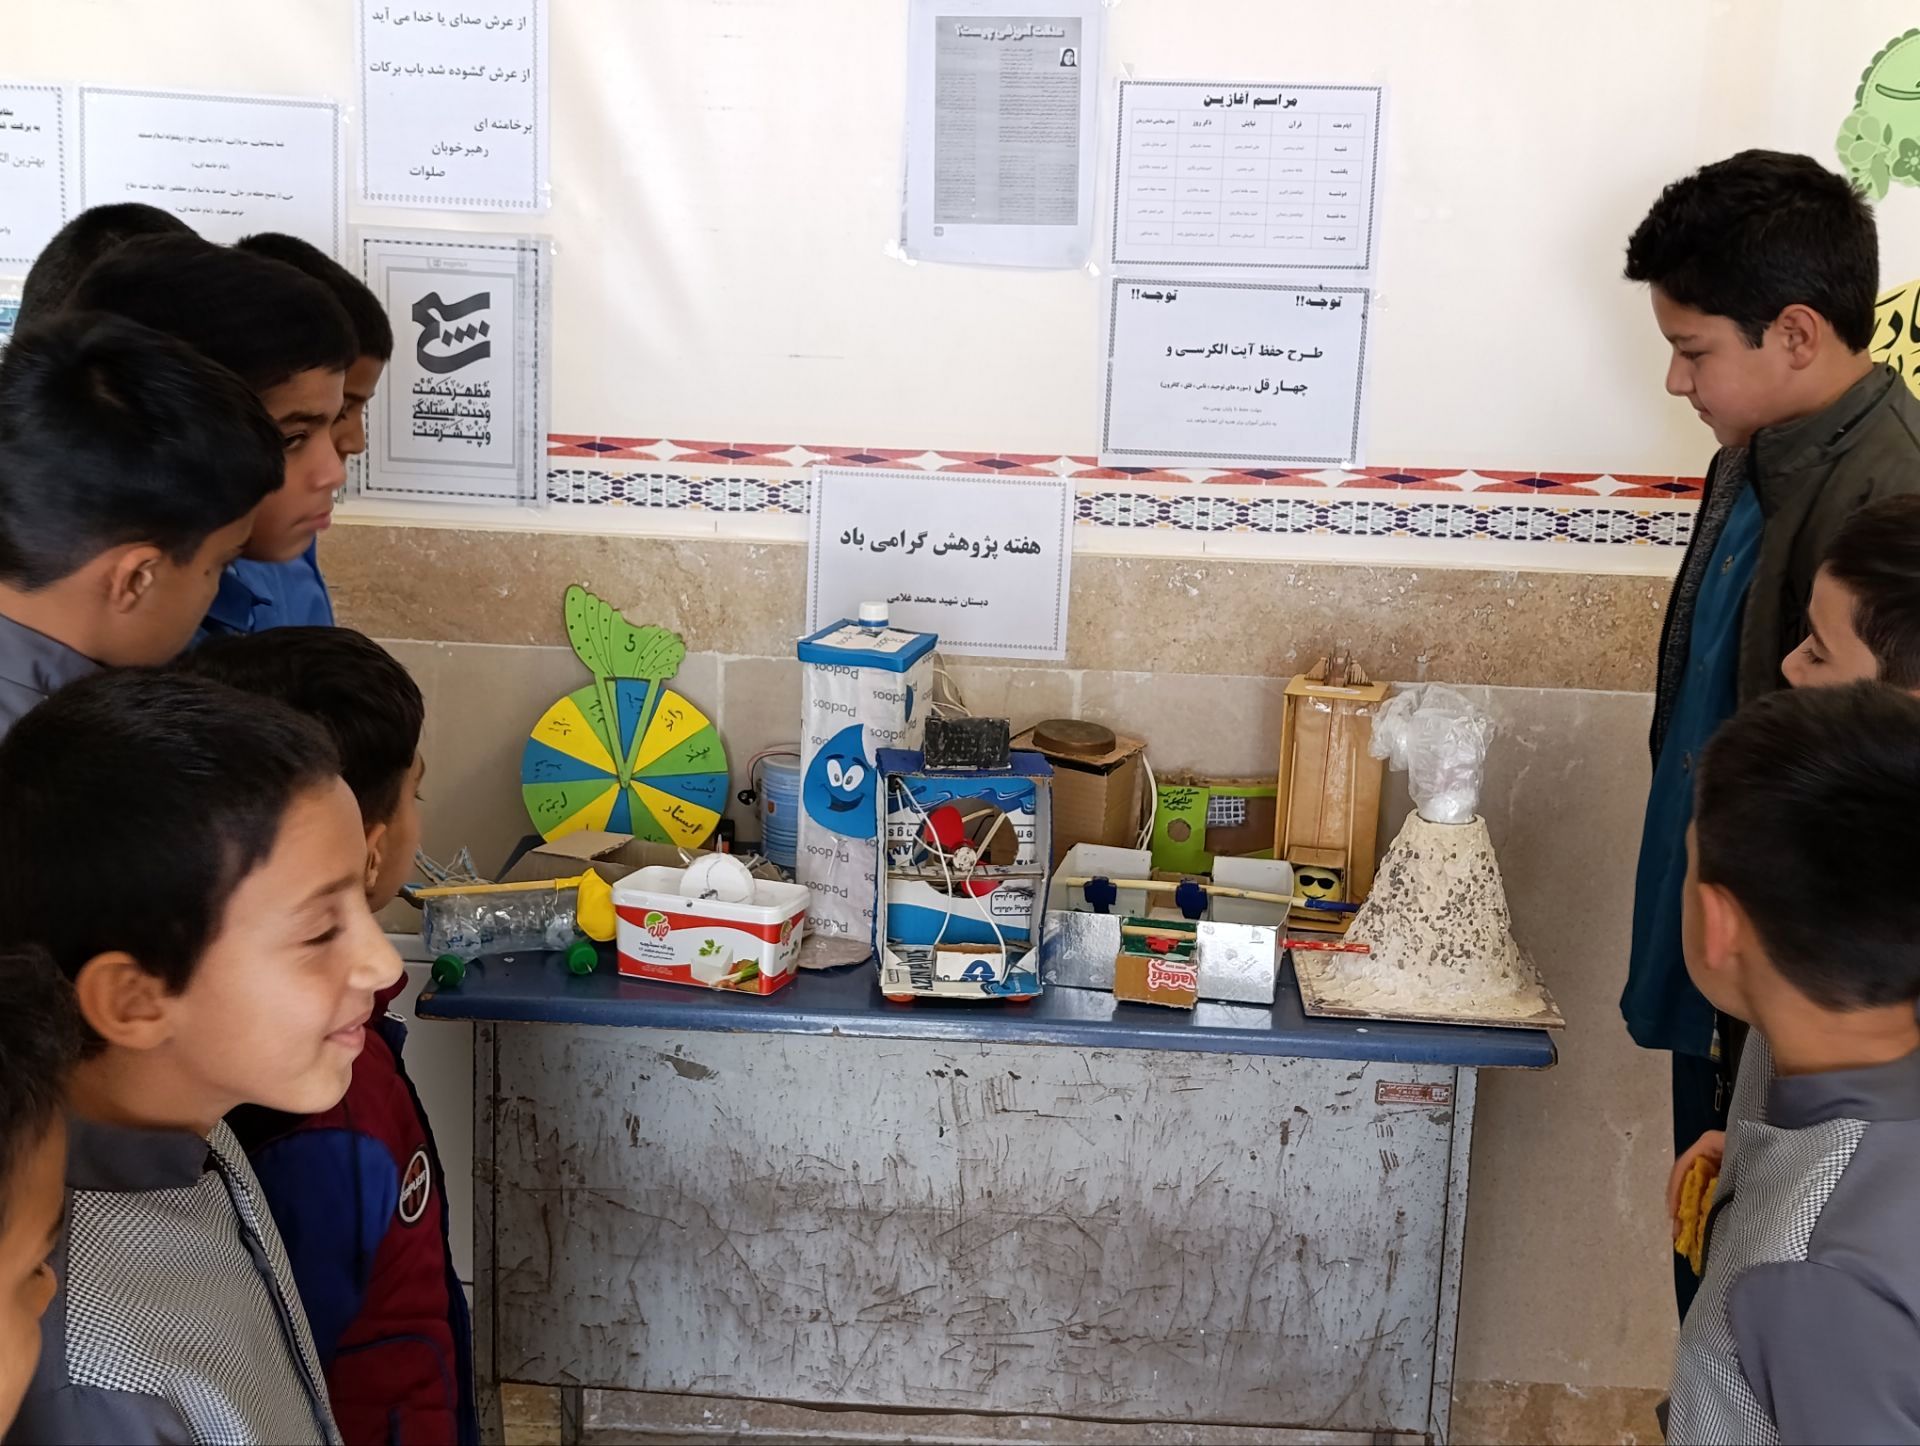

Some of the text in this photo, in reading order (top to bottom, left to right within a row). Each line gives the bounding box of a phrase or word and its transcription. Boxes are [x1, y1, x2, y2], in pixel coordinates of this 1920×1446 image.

[372, 6, 527, 30] از عرش صدای یا خدا می آید
[369, 60, 531, 83] از عرش گشوده شد باب برکات
[1203, 90, 1298, 109] مراسم آغازین
[408, 165, 446, 180] صلوات
[1131, 287, 1178, 303] توجه!!
[1295, 294, 1343, 311] توجه!!
[1165, 342, 1323, 363] طرح حفظ آیت الکرسی و
[1253, 377, 1271, 395] قل
[1272, 379, 1309, 397] چهار
[840, 526, 1041, 560] هفته پژوهش گرامی باد
[914, 594, 937, 604] محمد
[938, 595, 958, 606] شهید
[960, 597, 989, 608] دبستان
[813, 698, 857, 718] Padoos
[804, 880, 849, 899] Padoos
[808, 915, 849, 934] Padoo
